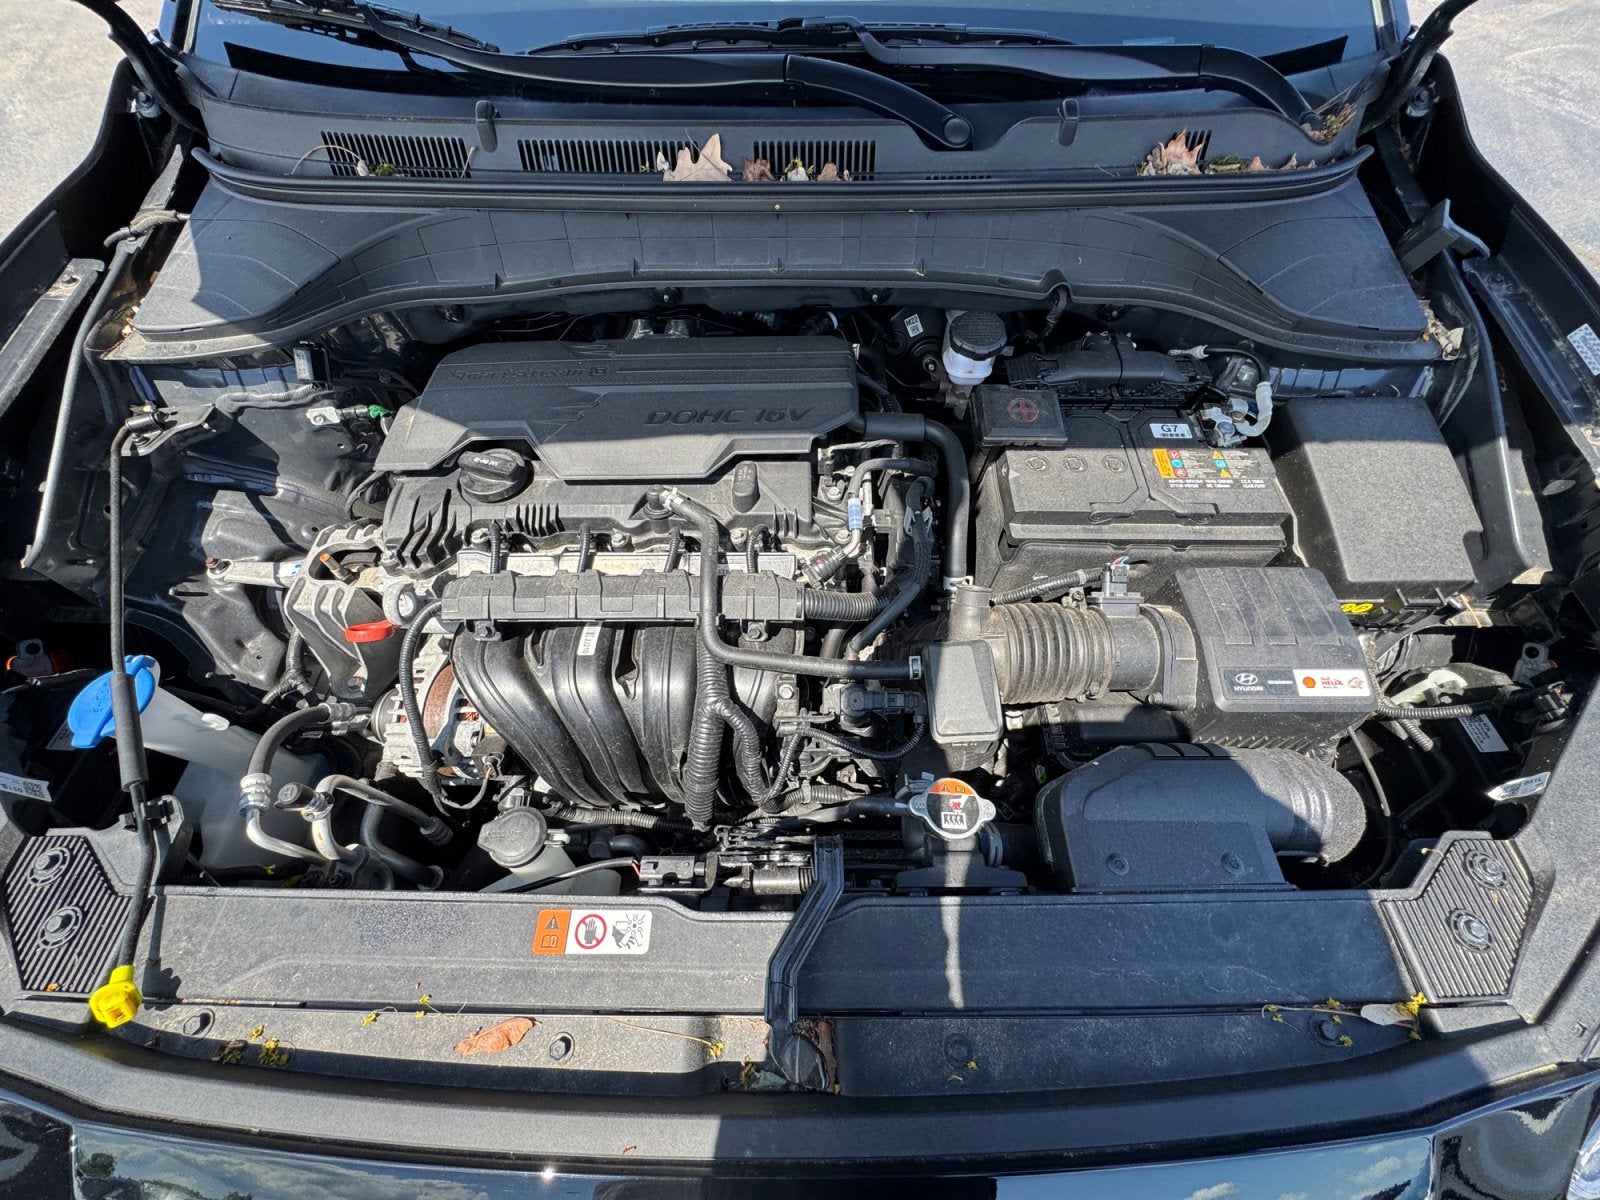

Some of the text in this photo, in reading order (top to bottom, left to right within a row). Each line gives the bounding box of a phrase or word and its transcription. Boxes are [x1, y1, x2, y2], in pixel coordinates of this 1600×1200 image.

[905, 316, 919, 326] M22
[643, 407, 814, 426] DOHC 16V
[1161, 424, 1178, 433] G7
